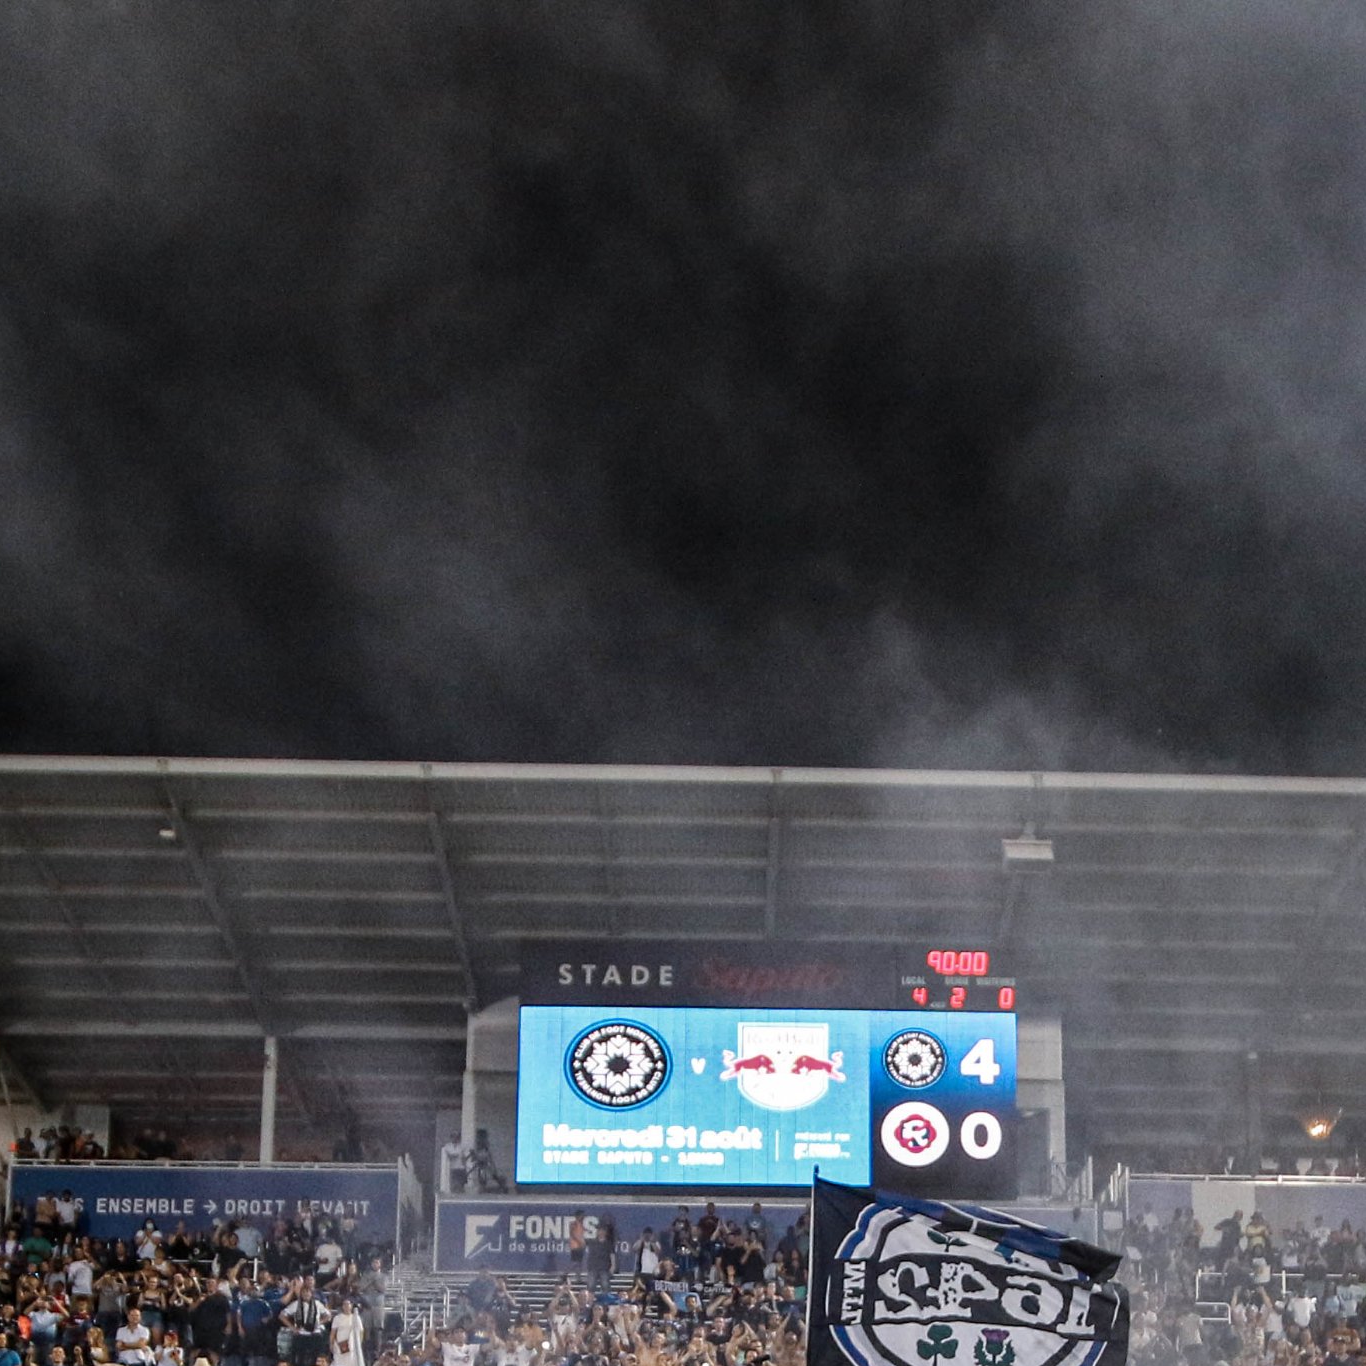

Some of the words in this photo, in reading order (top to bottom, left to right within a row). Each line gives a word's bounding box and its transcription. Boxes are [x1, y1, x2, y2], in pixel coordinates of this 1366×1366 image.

[558, 964, 674, 986] STADE
[912, 987, 927, 1008] 4
[949, 986, 966, 1009] 2
[960, 1038, 1001, 1085] 4
[666, 1125, 697, 1149] 31
[960, 1111, 1002, 1160] 0
[95, 1197, 195, 1214] ENSEMBLE
[224, 1199, 285, 1215] DROIT
[508, 1242, 525, 1254] de
